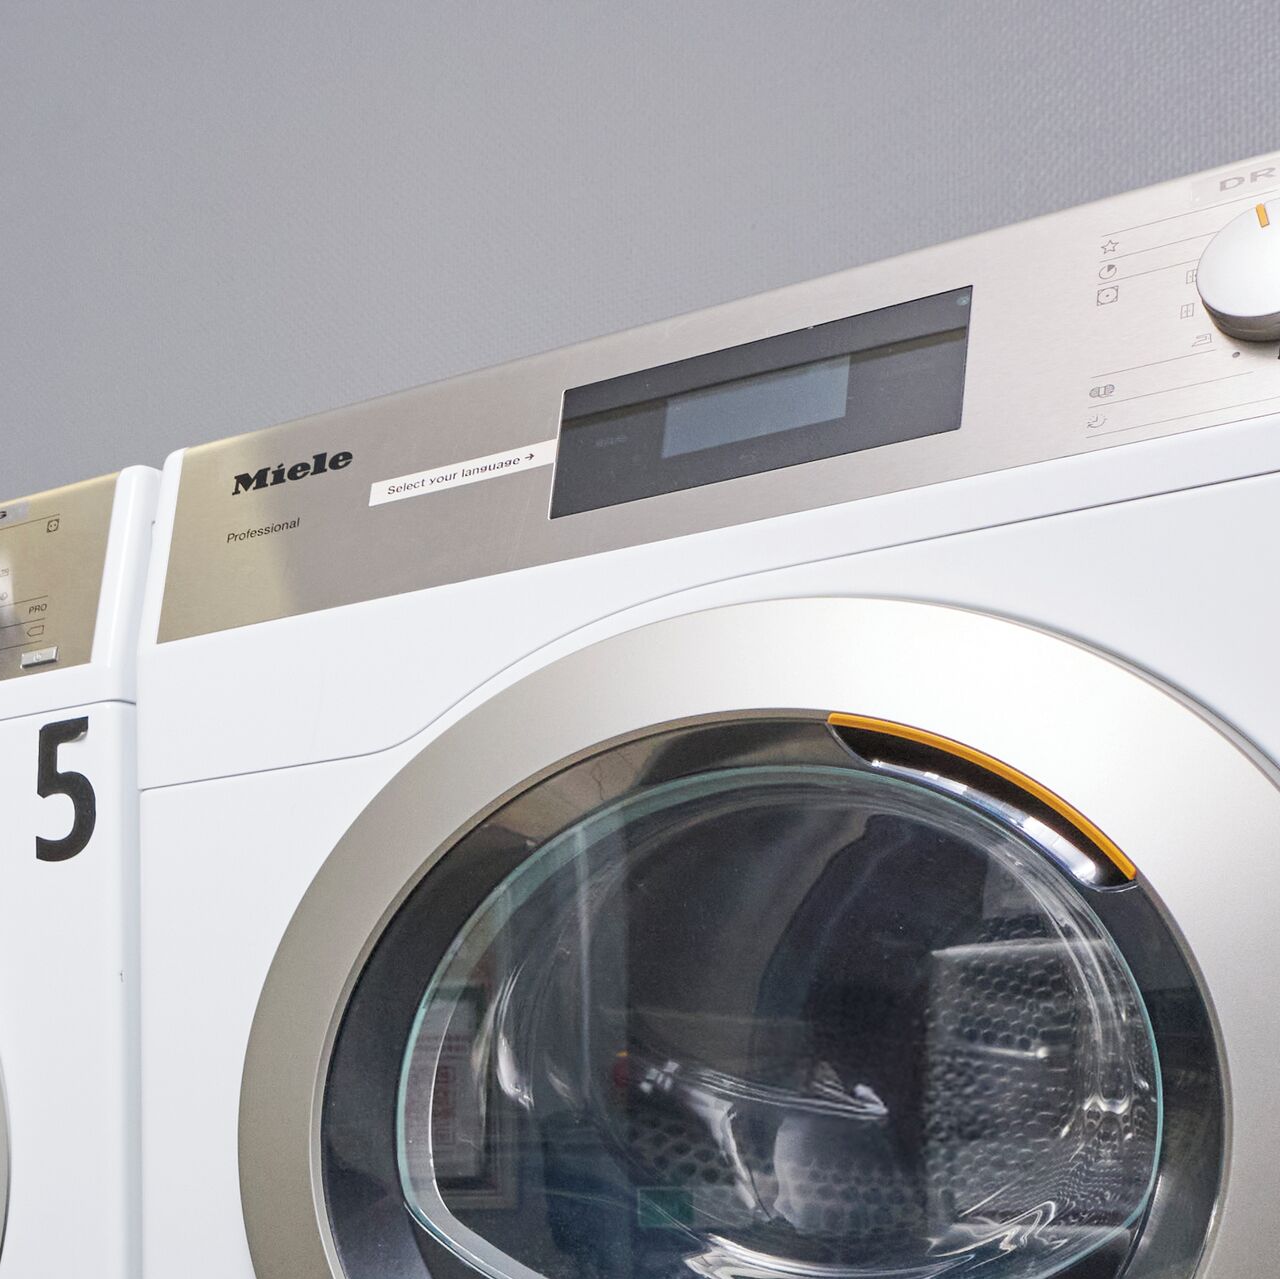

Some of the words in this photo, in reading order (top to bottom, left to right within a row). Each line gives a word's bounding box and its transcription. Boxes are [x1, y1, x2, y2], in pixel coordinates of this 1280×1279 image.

[232, 451, 353, 495] Miele
[387, 478, 425, 495] Select
[429, 472, 458, 486] your
[461, 456, 521, 479] language
[226, 517, 301, 544] Professional
[28, 603, 48, 615] PRO
[36, 716, 96, 862] 5
